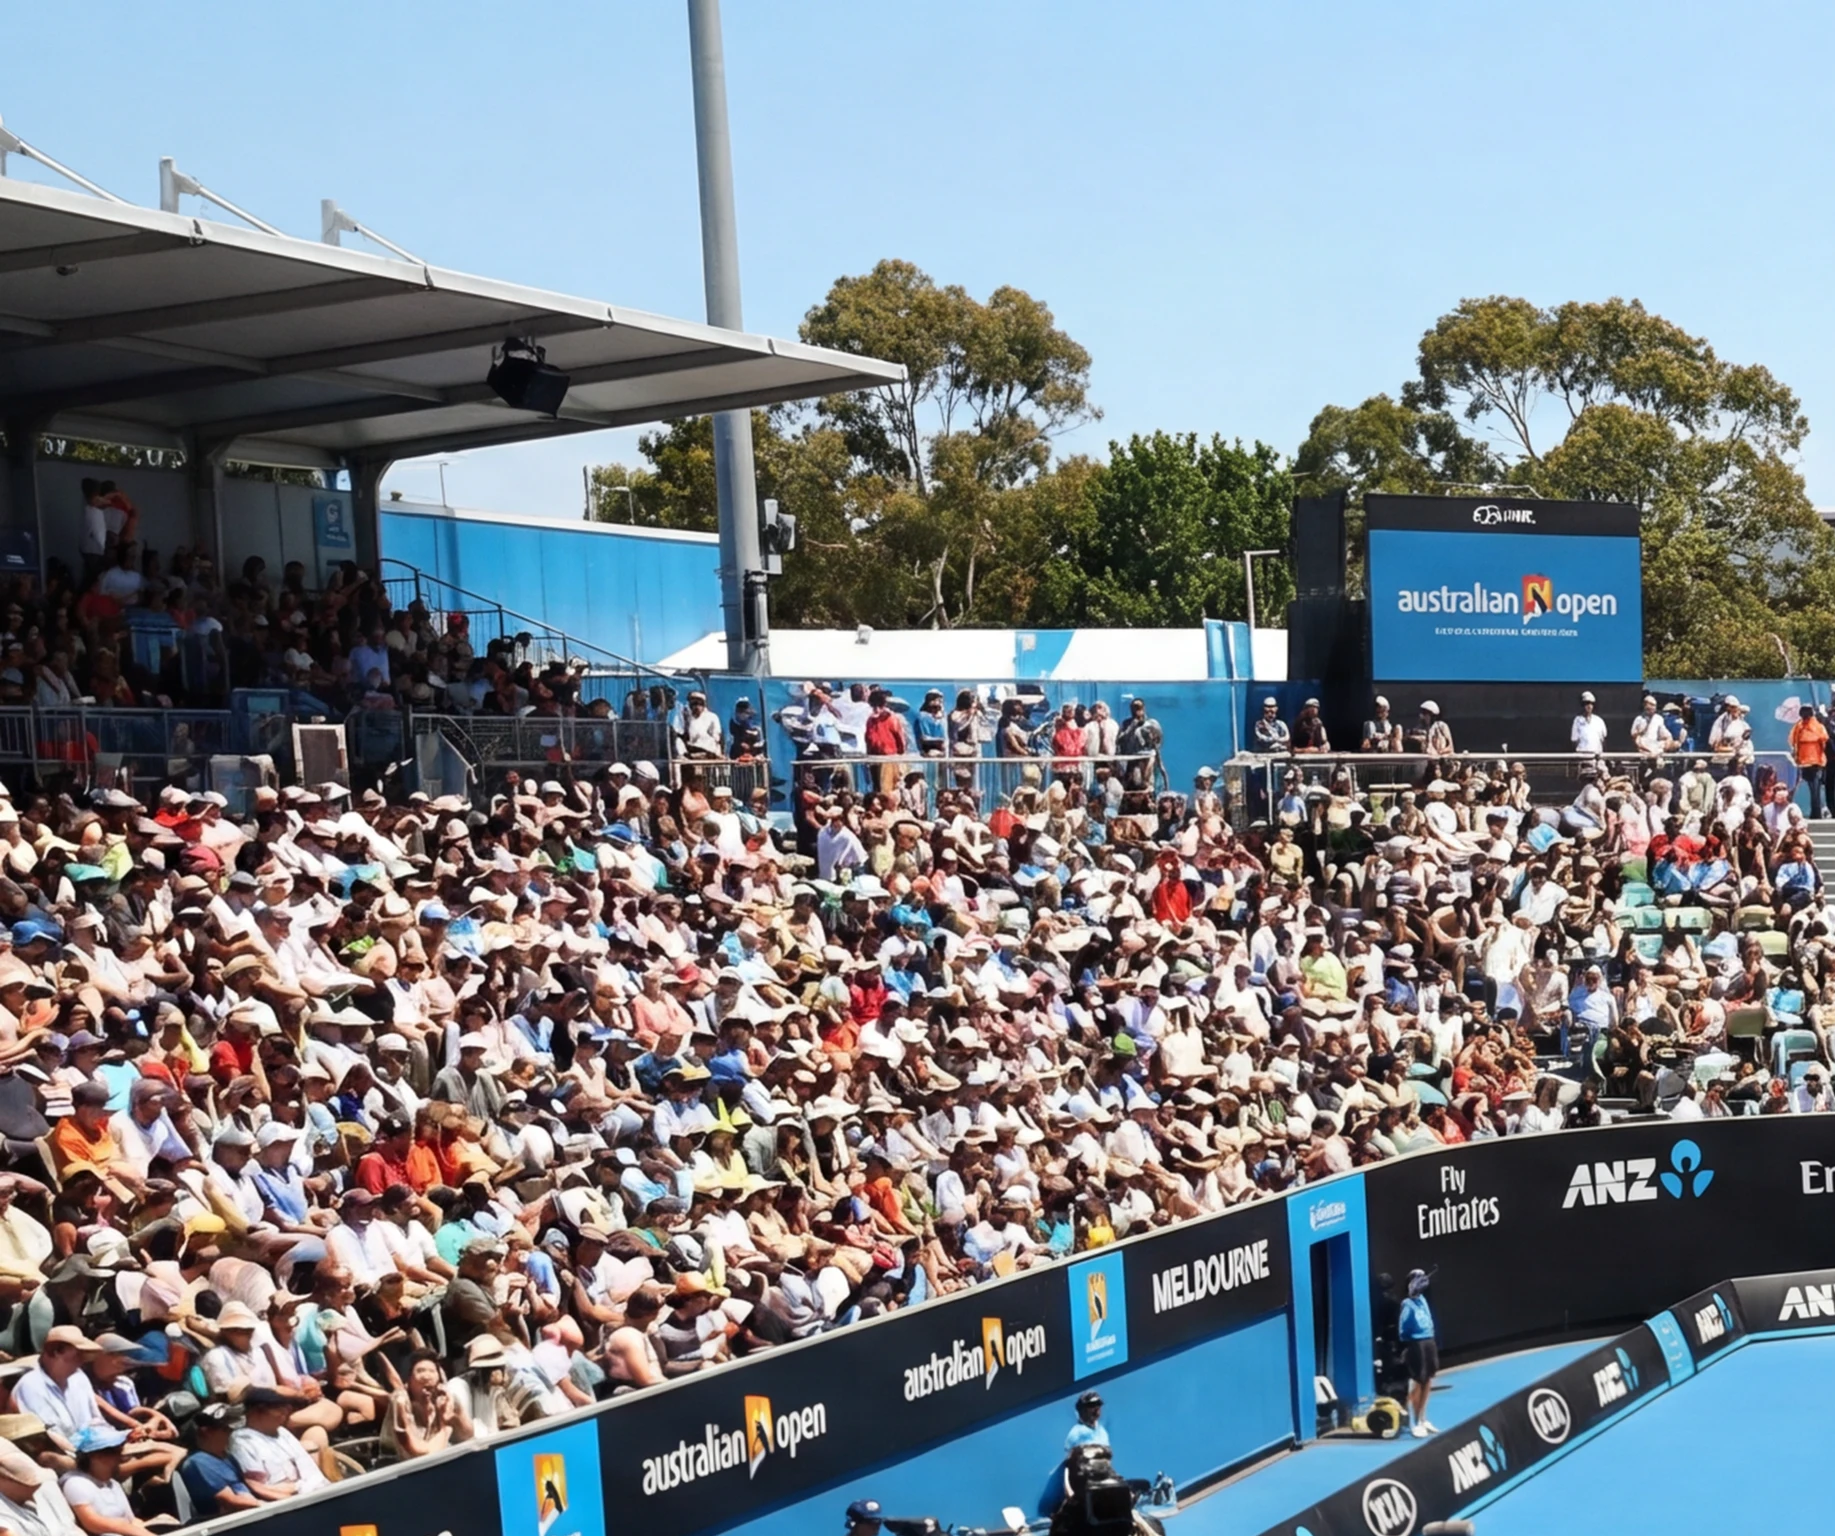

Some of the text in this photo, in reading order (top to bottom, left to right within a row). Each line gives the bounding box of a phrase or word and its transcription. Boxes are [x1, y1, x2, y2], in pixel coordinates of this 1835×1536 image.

[1398, 582, 1618, 623] australian open
[1440, 1165, 1466, 1195] Fly
[1562, 1157, 1658, 1209] ANZ
[904, 1339, 984, 1401] australian
[1006, 1324, 1046, 1375] open
[642, 1402, 827, 1496] australian open
